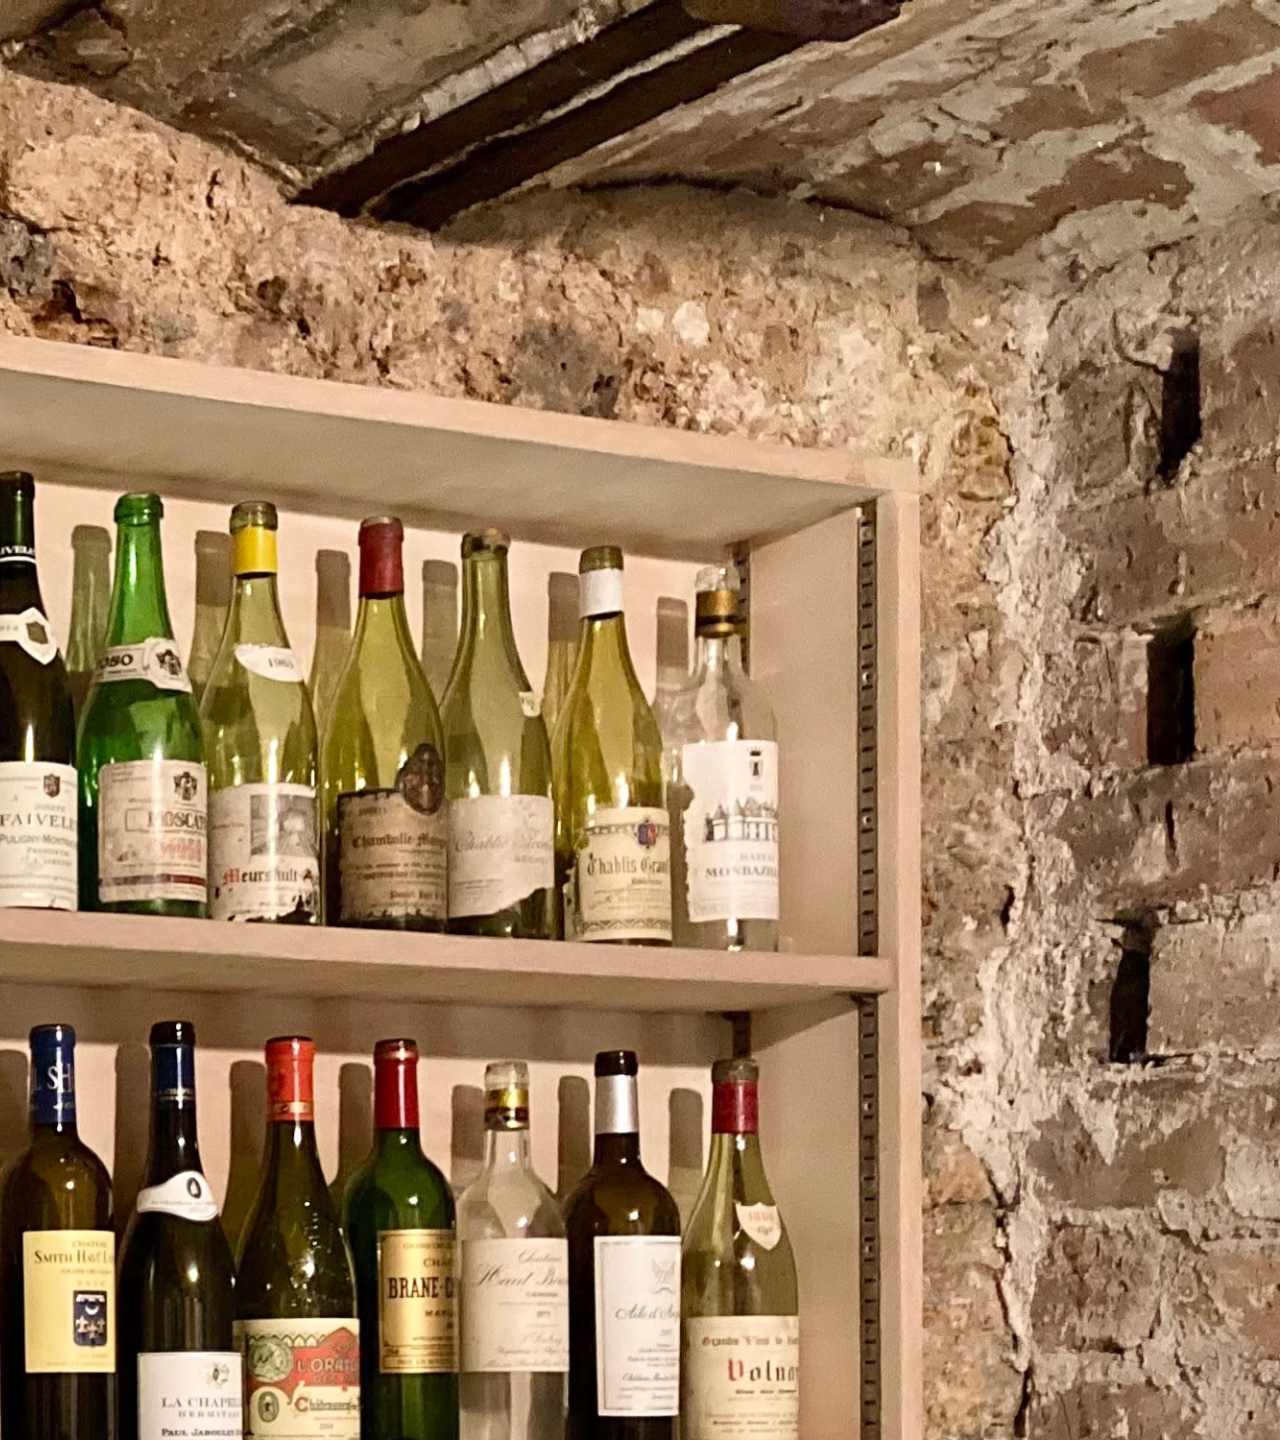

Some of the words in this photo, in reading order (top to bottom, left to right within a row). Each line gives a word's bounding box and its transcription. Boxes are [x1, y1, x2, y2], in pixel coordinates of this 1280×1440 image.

[587, 852, 637, 876] Chablis
[223, 864, 298, 885] Meursult
[34, 1249, 74, 1265] SMITH
[161, 1397, 184, 1408] LA
[161, 1428, 188, 1437] PAUL
